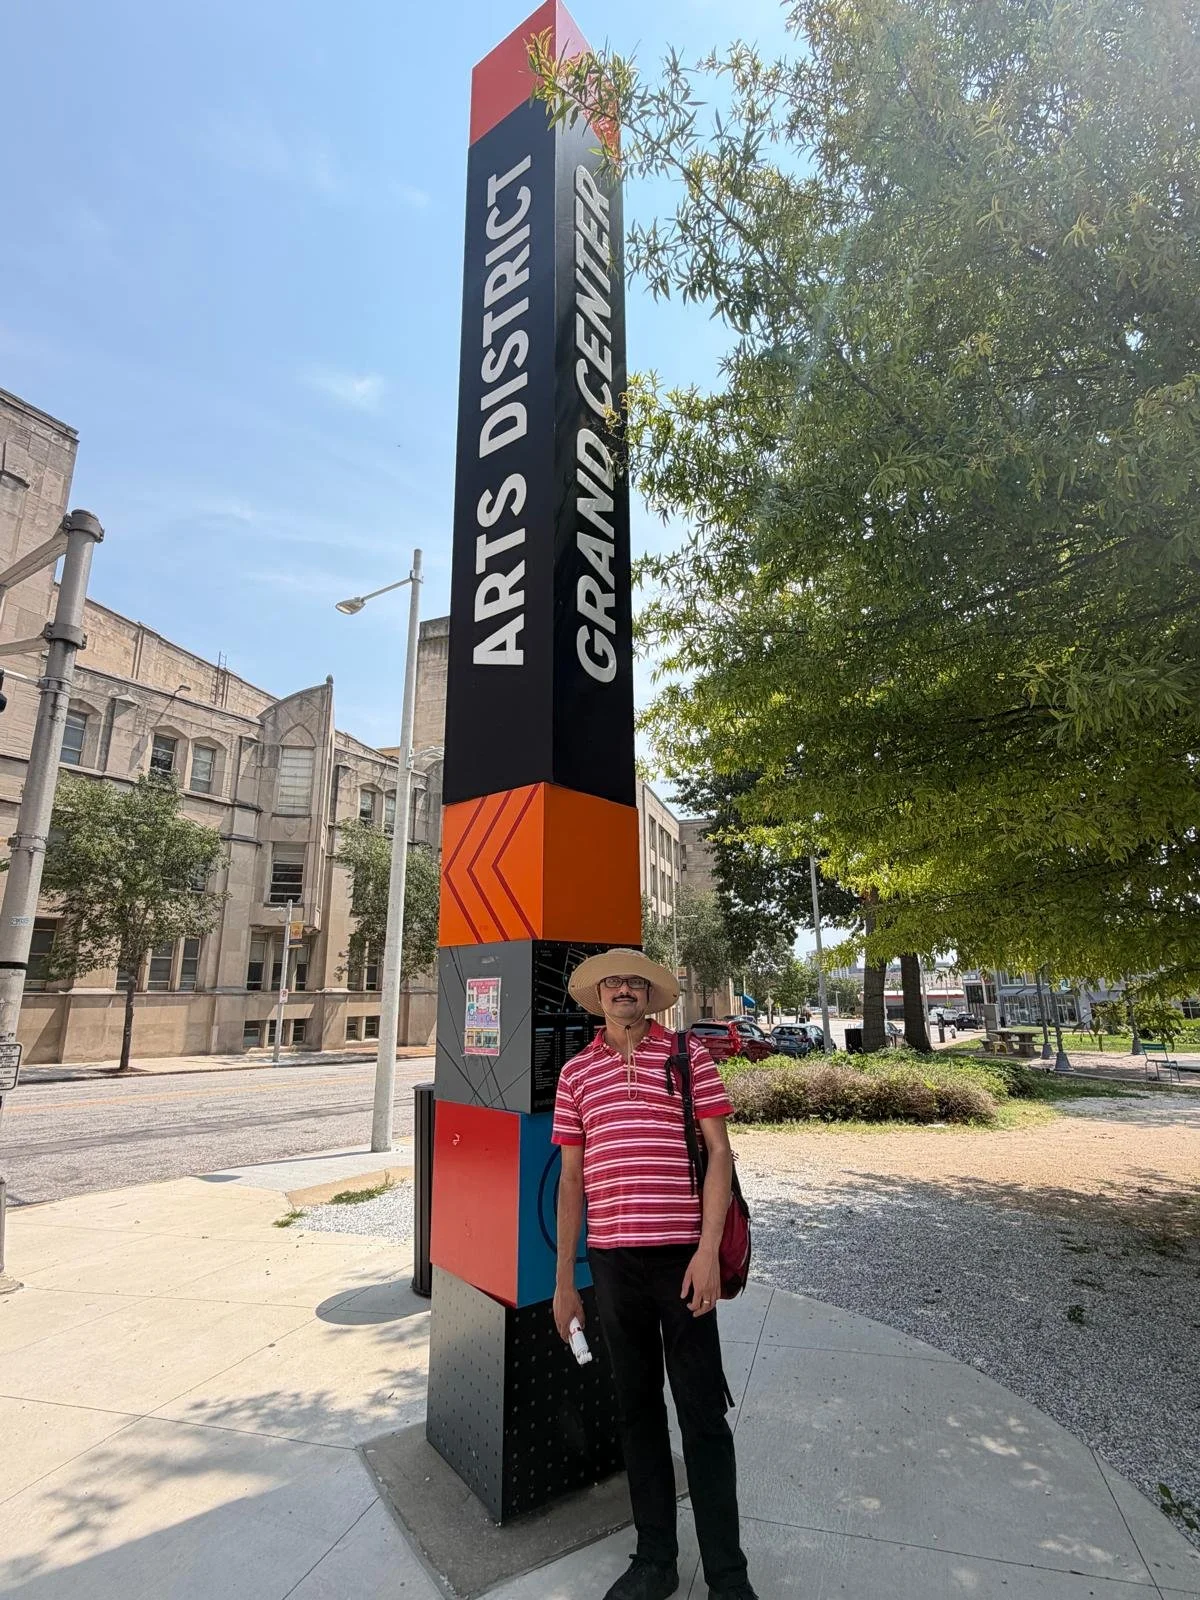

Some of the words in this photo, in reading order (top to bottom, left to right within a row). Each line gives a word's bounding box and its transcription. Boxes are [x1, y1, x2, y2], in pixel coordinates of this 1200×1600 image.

[479, 155, 532, 458] DISTRICT
[575, 165, 613, 420] CENTER
[473, 473, 527, 665] ARTS
[576, 428, 617, 683] GRAND
